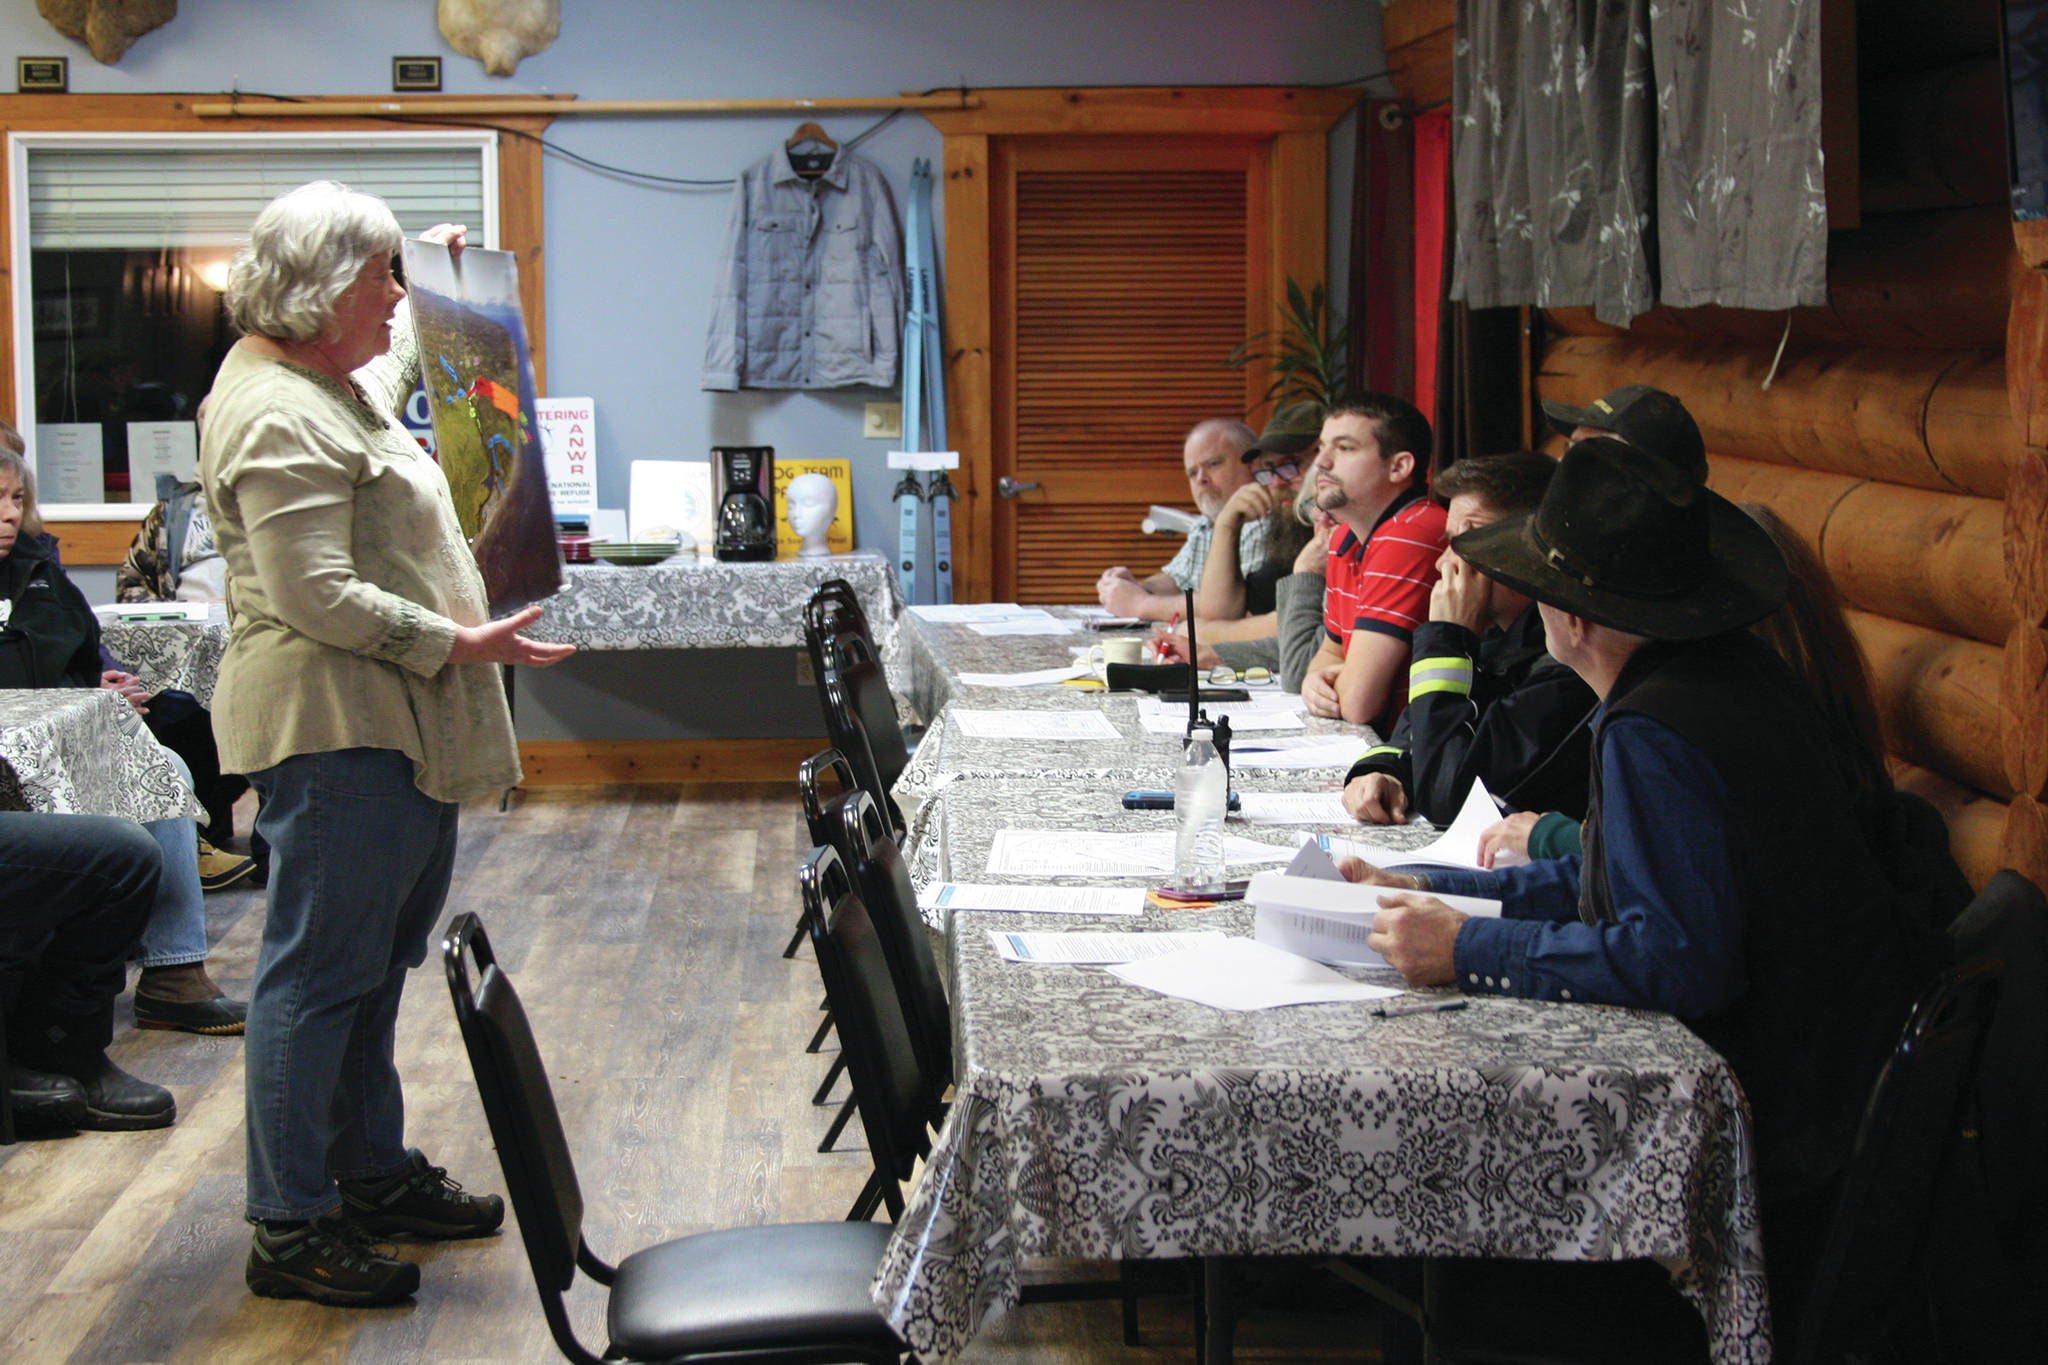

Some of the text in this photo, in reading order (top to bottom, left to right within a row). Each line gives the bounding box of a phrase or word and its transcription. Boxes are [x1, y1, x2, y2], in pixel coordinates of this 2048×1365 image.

[537, 409, 590, 421] TERING
[567, 423, 587, 475] ANWR
[774, 466, 795, 480] OG
[551, 481, 592, 489] NATIONAL
